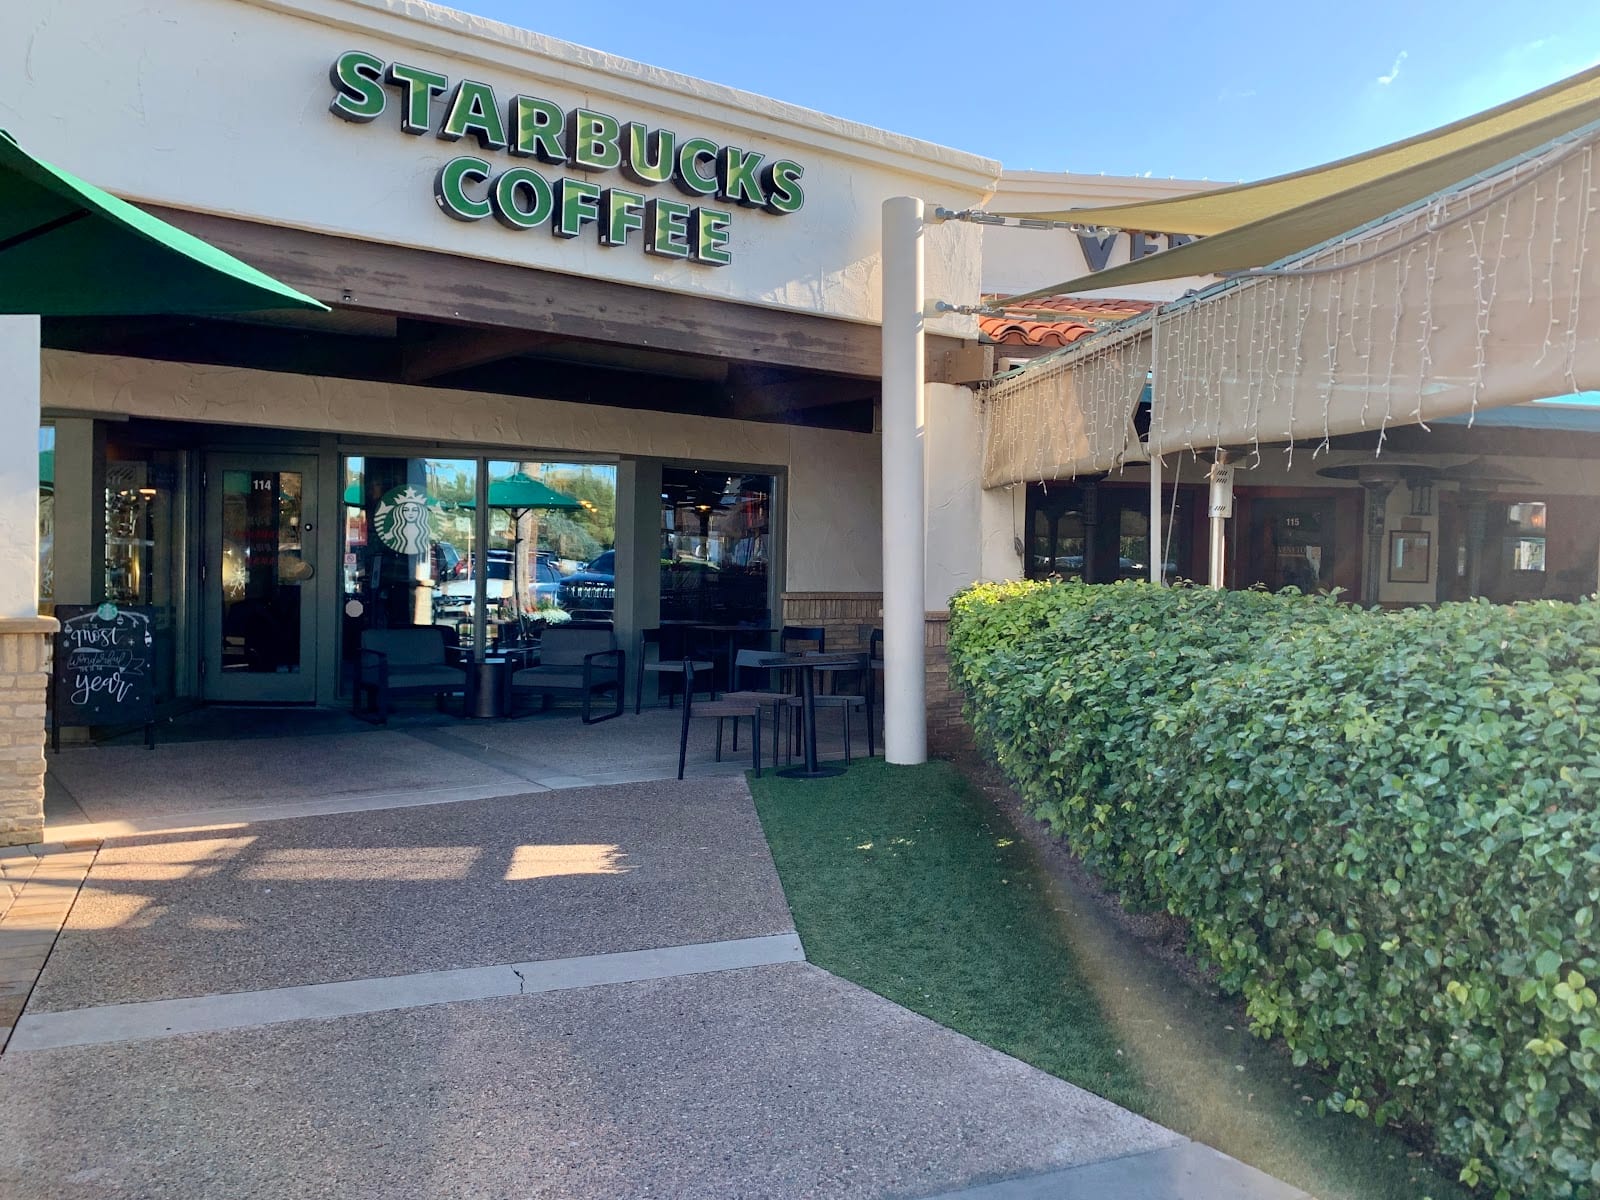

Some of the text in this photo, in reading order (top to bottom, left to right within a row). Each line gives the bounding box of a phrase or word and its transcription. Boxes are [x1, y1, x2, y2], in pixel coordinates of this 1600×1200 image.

[329, 50, 805, 215] STARBUCKS
[434, 155, 732, 266] COFFEE
[252, 479, 272, 491] 114
[1286, 517, 1300, 527] 115
[71, 671, 133, 704] year
